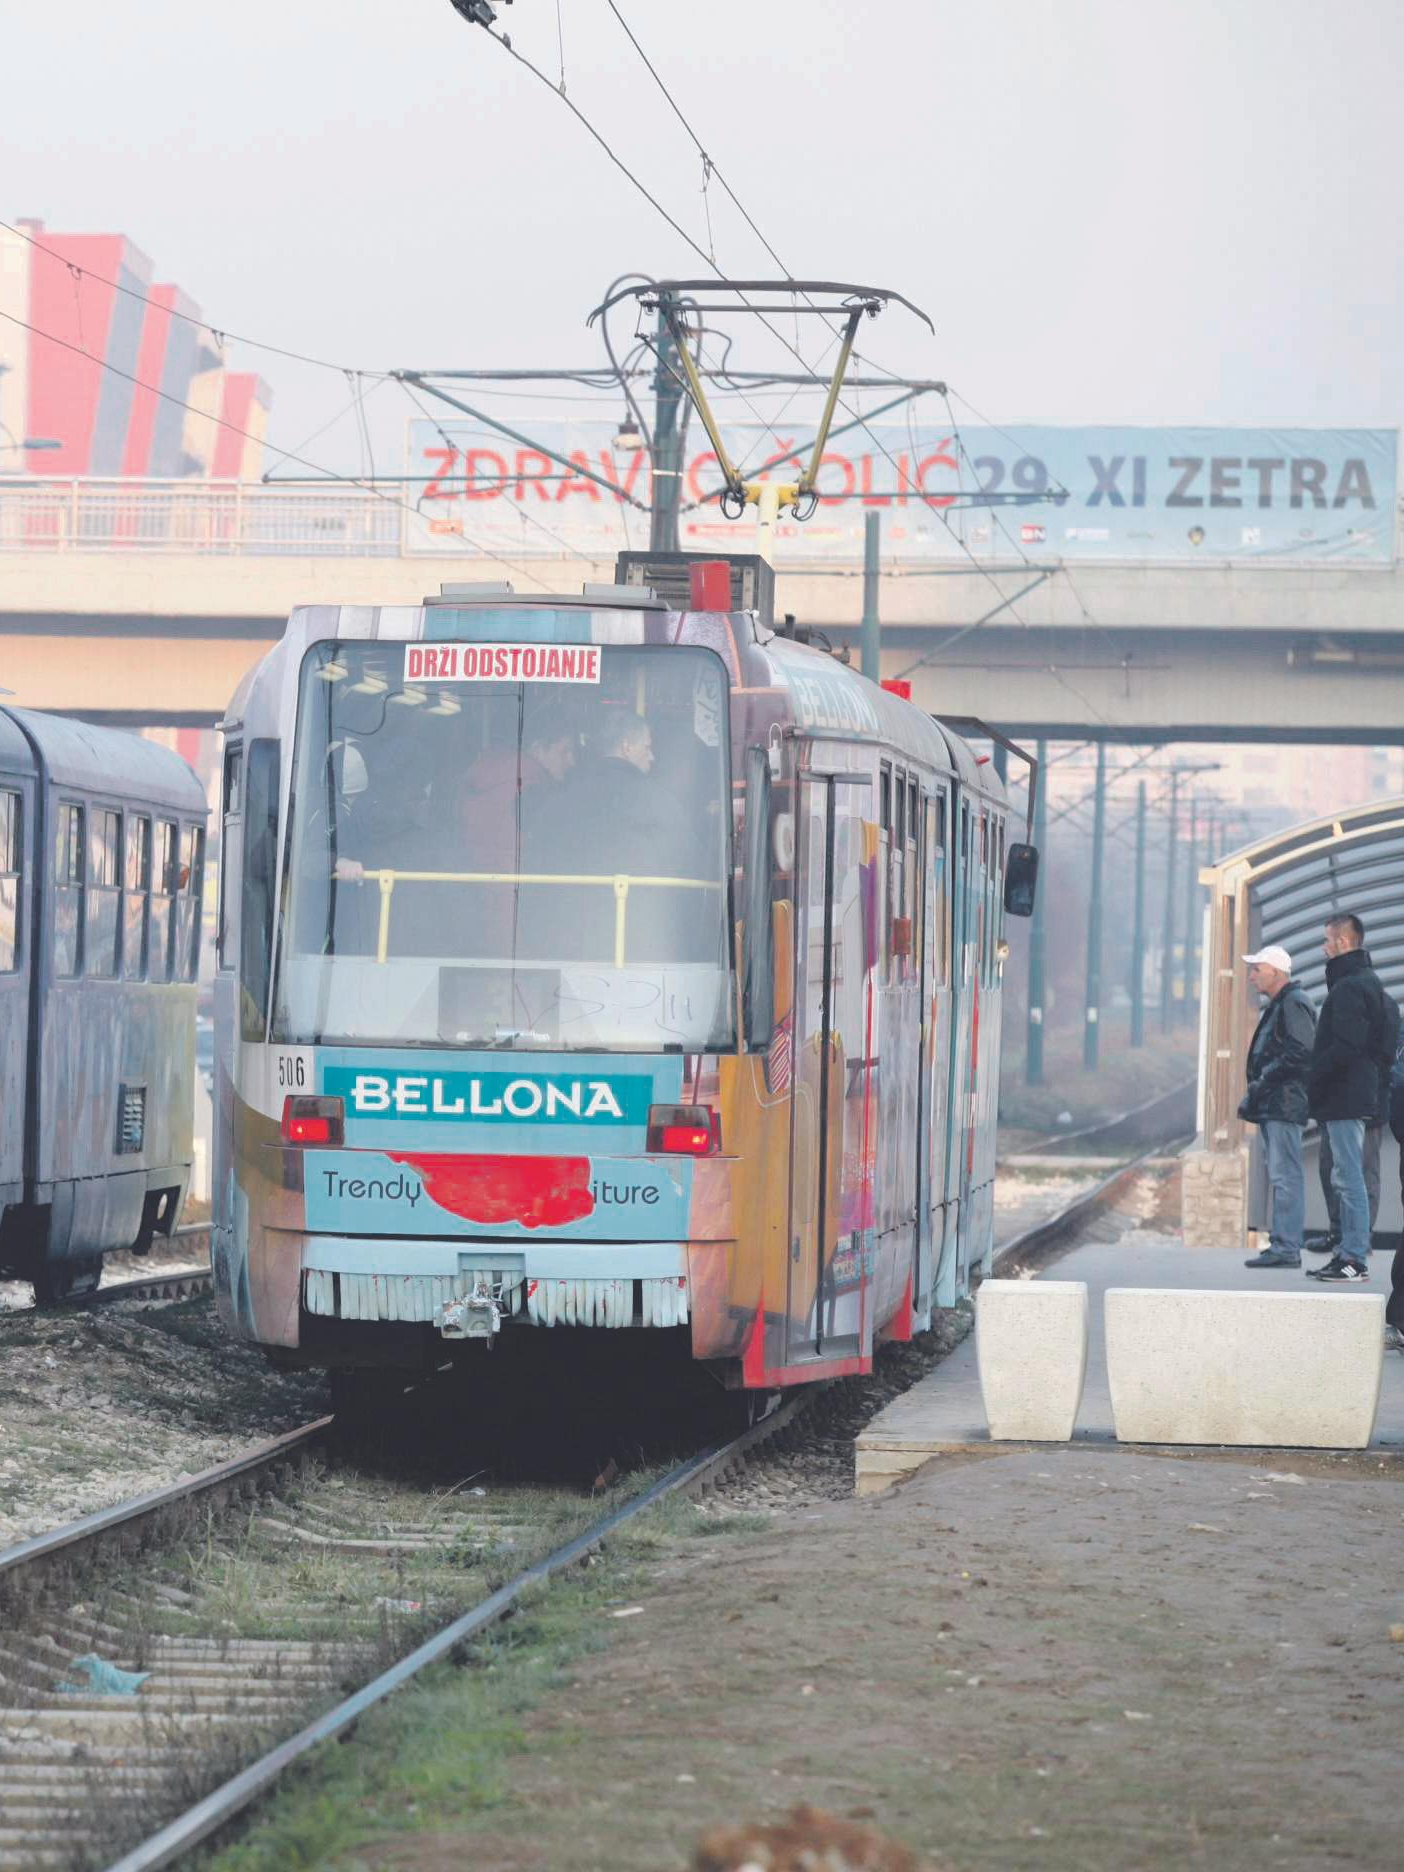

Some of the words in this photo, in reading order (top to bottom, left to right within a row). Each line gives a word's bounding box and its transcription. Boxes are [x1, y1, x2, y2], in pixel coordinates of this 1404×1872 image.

[422, 447, 736, 504] ZDRAVO
[1084, 455, 1148, 509] XI
[1164, 456, 1378, 511] ZETRA
[407, 646, 458, 678] DRŽI
[463, 648, 597, 679] ODSTOJANJE
[278, 1056, 305, 1088] 506
[350, 1074, 624, 1118] BELLONA
[322, 1170, 422, 1208] Trendy
[593, 1179, 660, 1206] iture
